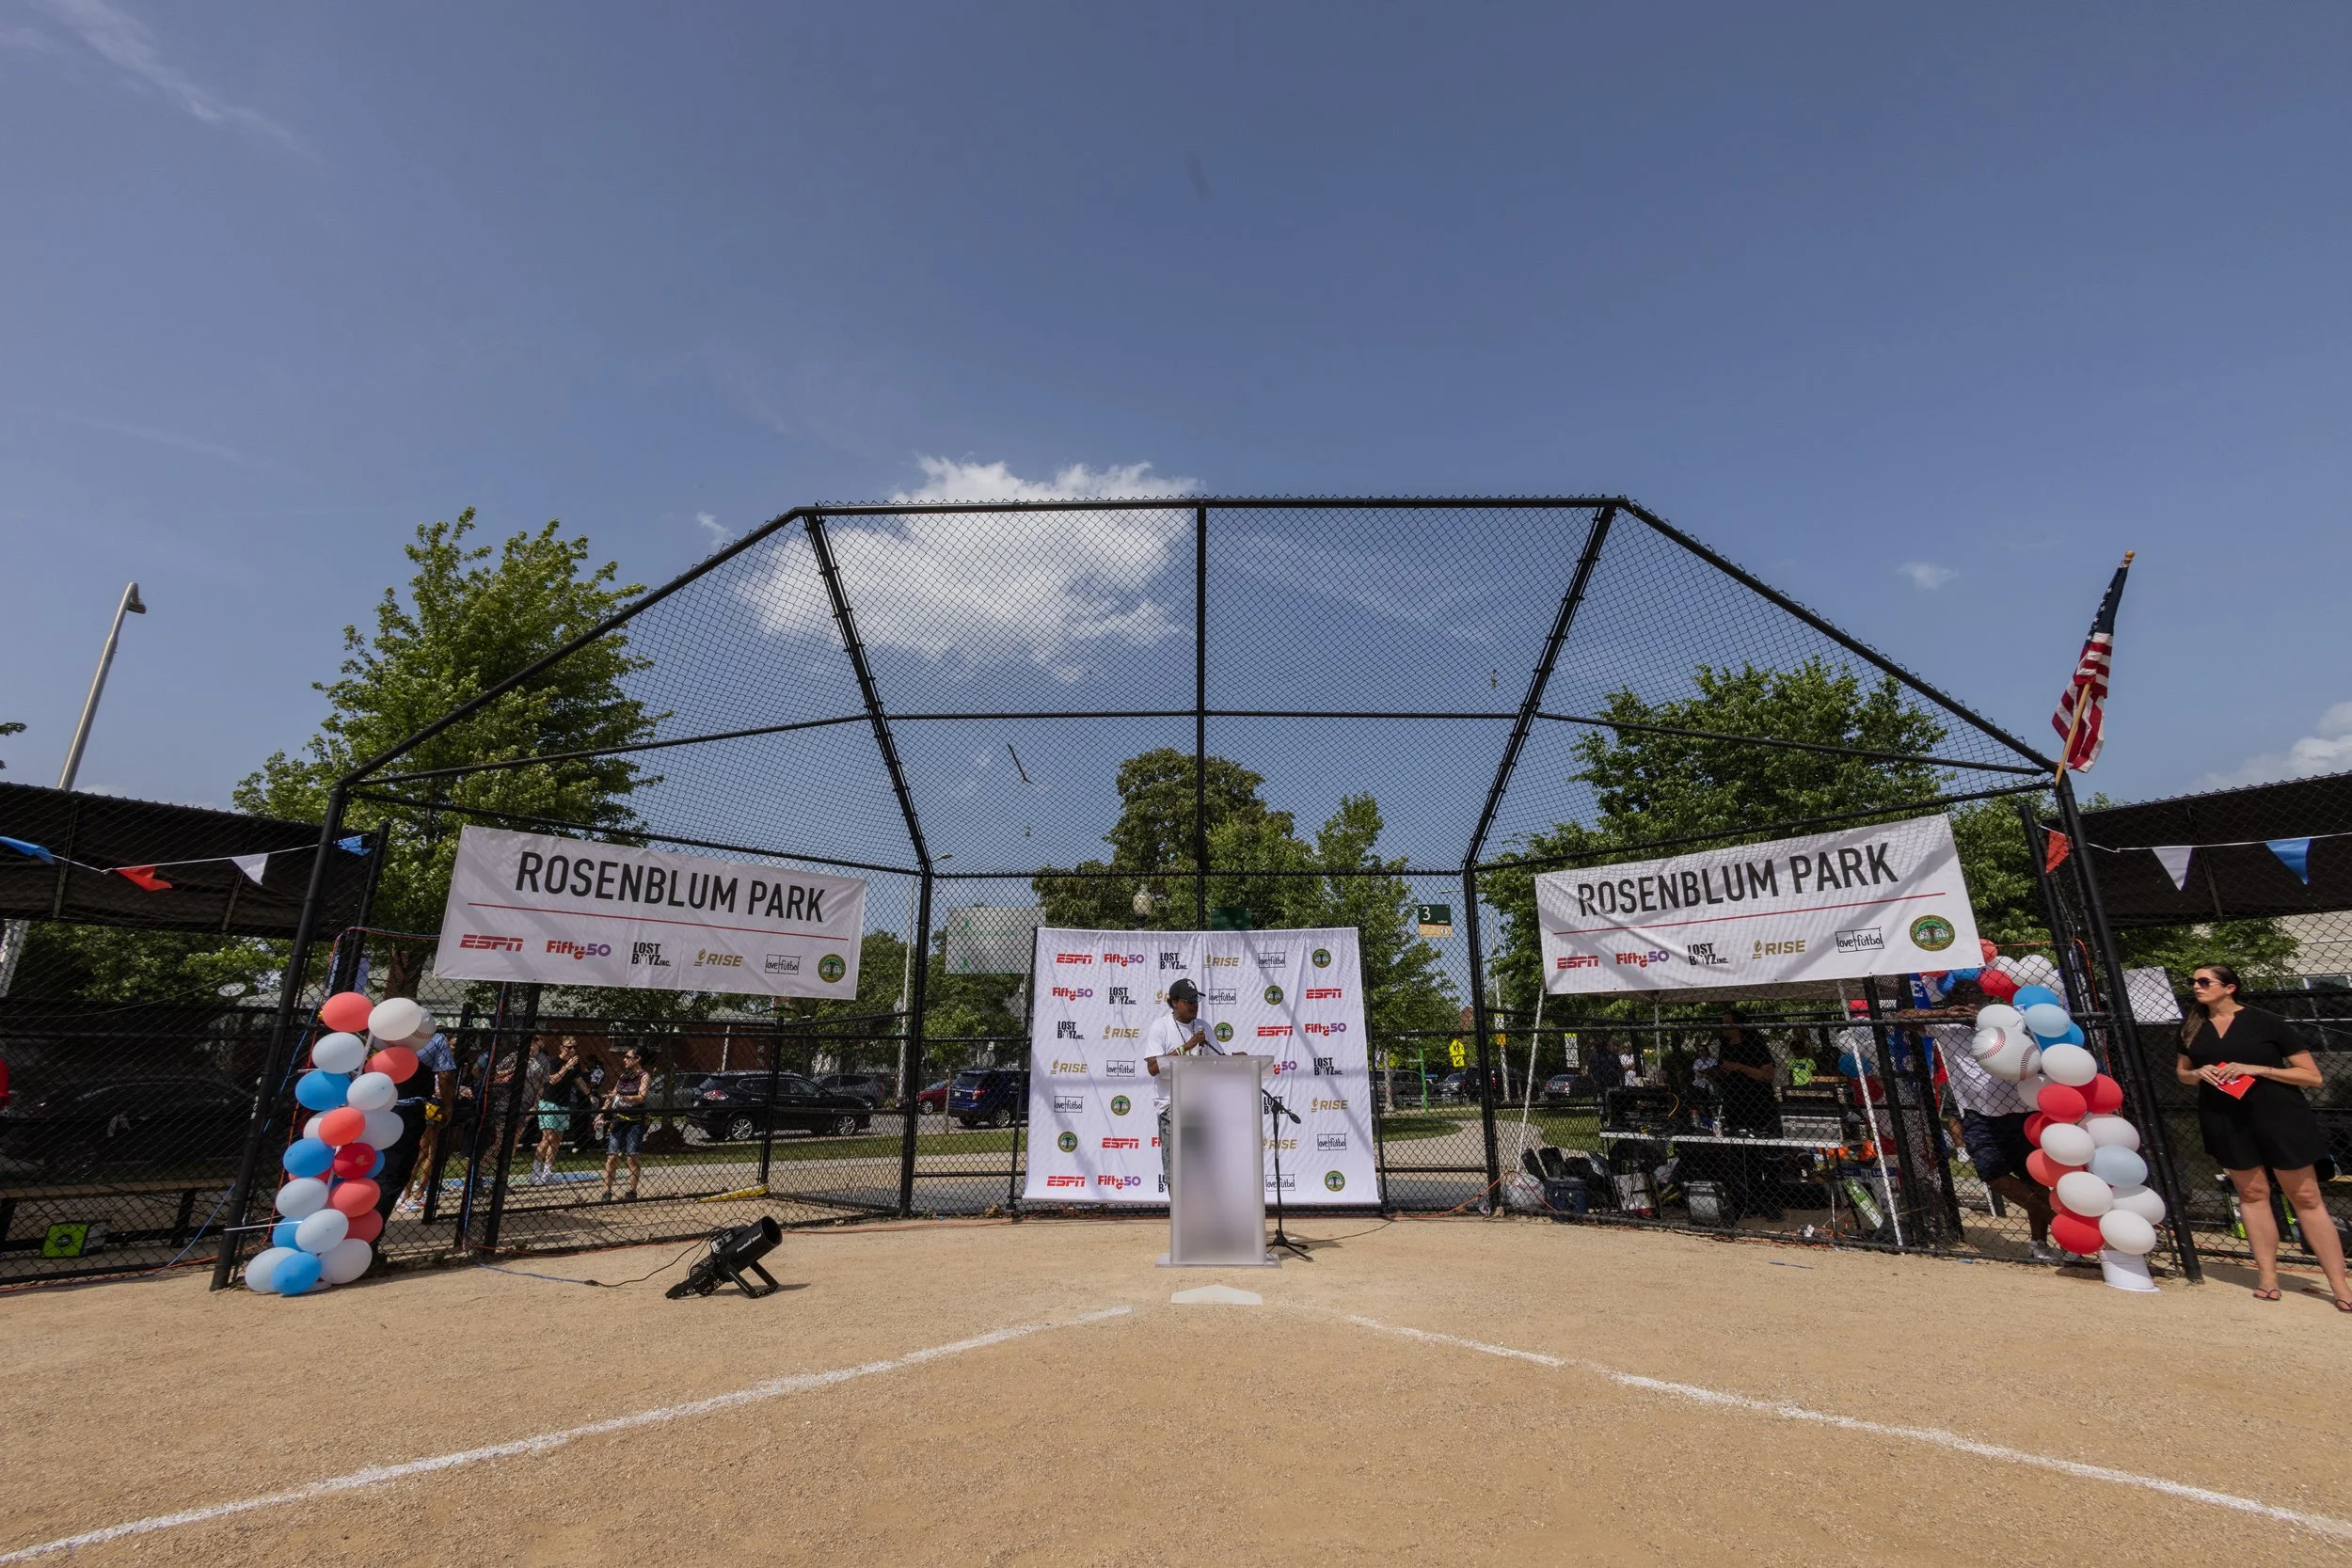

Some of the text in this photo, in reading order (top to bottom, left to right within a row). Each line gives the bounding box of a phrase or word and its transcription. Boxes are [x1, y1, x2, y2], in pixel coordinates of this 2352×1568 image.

[1578, 842, 1899, 916] ROSENBLUM PARK
[516, 851, 825, 923] ROSENBLUM PARK
[1422, 906, 1431, 921] 3
[459, 934, 523, 953] ESPN
[633, 942, 660, 955] LOST
[1687, 943, 1713, 955] LOST
[1765, 940, 1806, 956] RISE
[707, 953, 743, 967] RISE
[1056, 953, 1092, 964] ESPN
[1160, 952, 1179, 961] LOST
[1212, 957, 1239, 967] RISE
[1557, 956, 1598, 969] ESPN
[1109, 987, 1128, 996] LOST
[1306, 989, 1342, 999] ESPN
[1057, 1021, 1076, 1030] LOST
[1257, 1025, 1293, 1037] ESPN
[1111, 1028, 1140, 1038] RISE
[1313, 1057, 1333, 1067] LOST
[1059, 1063, 1087, 1073] RISE
[1320, 1100, 1348, 1110] RISE
[1102, 1137, 1139, 1148] ESPN
[1047, 1175, 1086, 1187] ESPN
